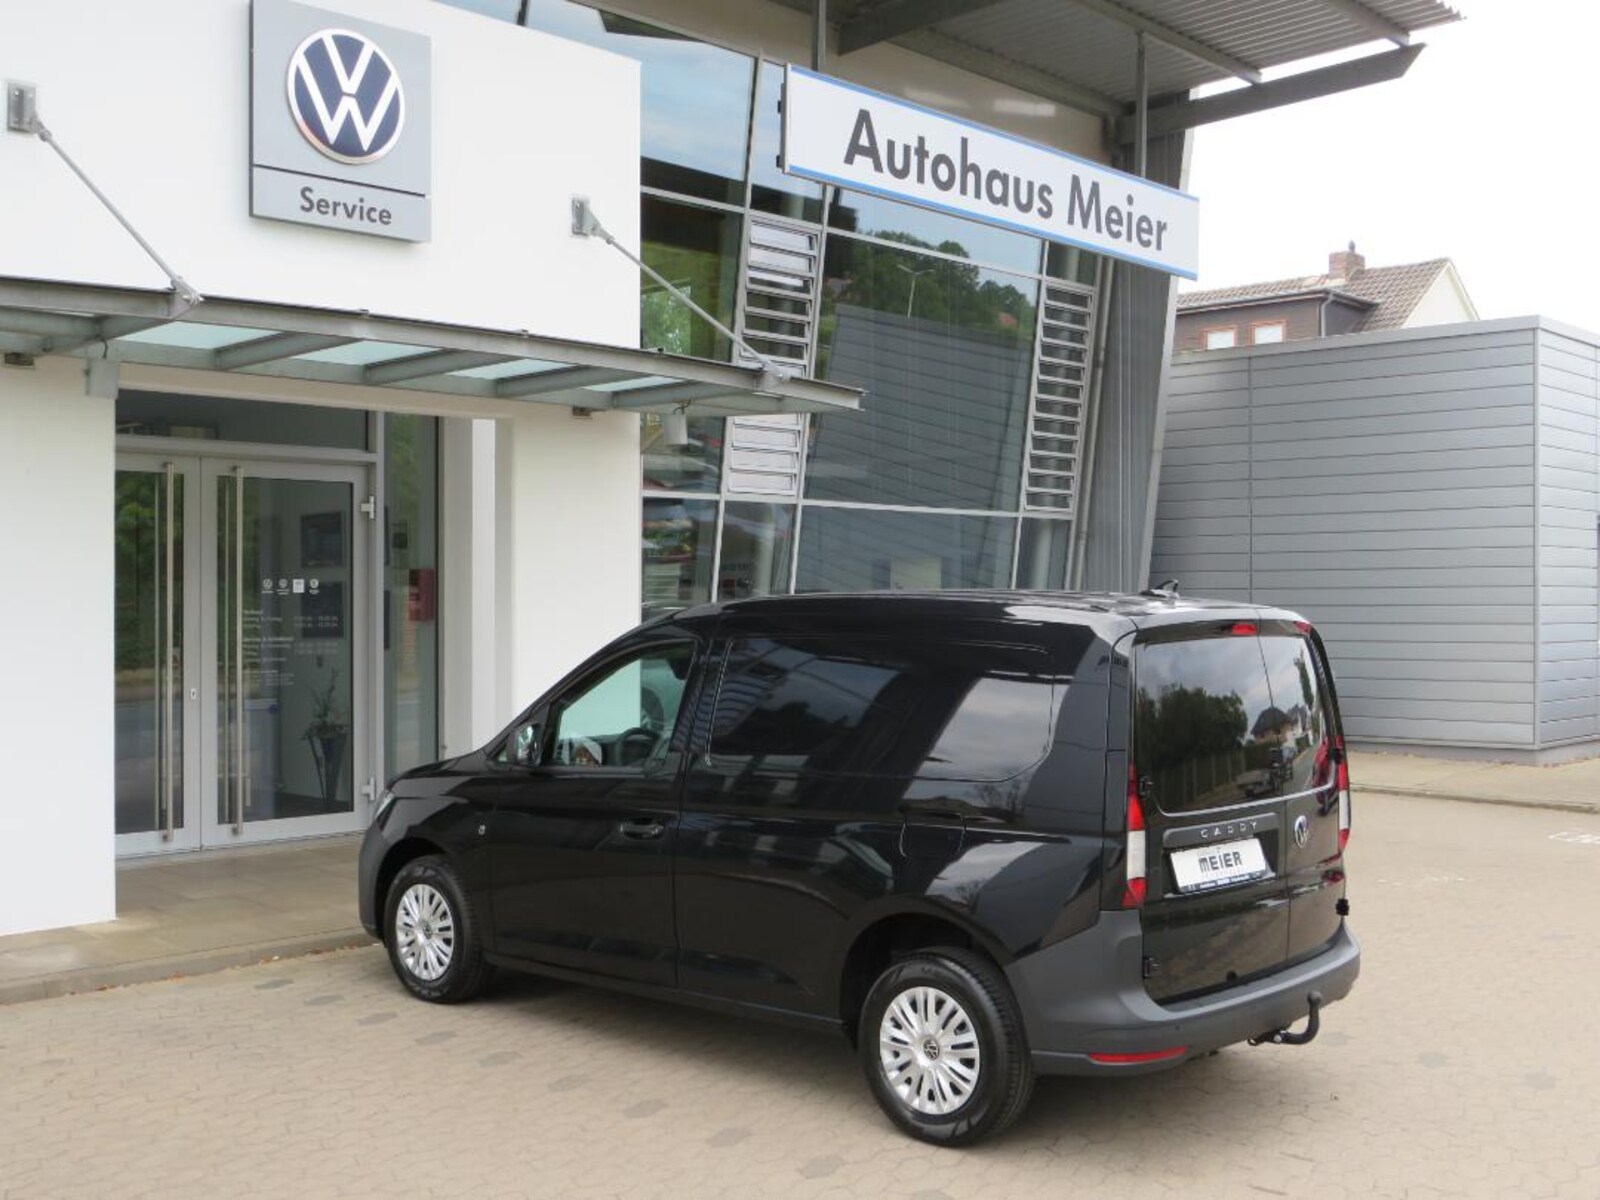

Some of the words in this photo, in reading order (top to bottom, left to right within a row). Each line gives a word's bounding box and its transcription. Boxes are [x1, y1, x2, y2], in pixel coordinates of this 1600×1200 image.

[844, 109, 1053, 219] Autohaus
[1067, 175, 1167, 251] Meier
[300, 187, 392, 225] Service
[1201, 822, 1257, 838] CADDY
[1199, 852, 1243, 873] MEIER
